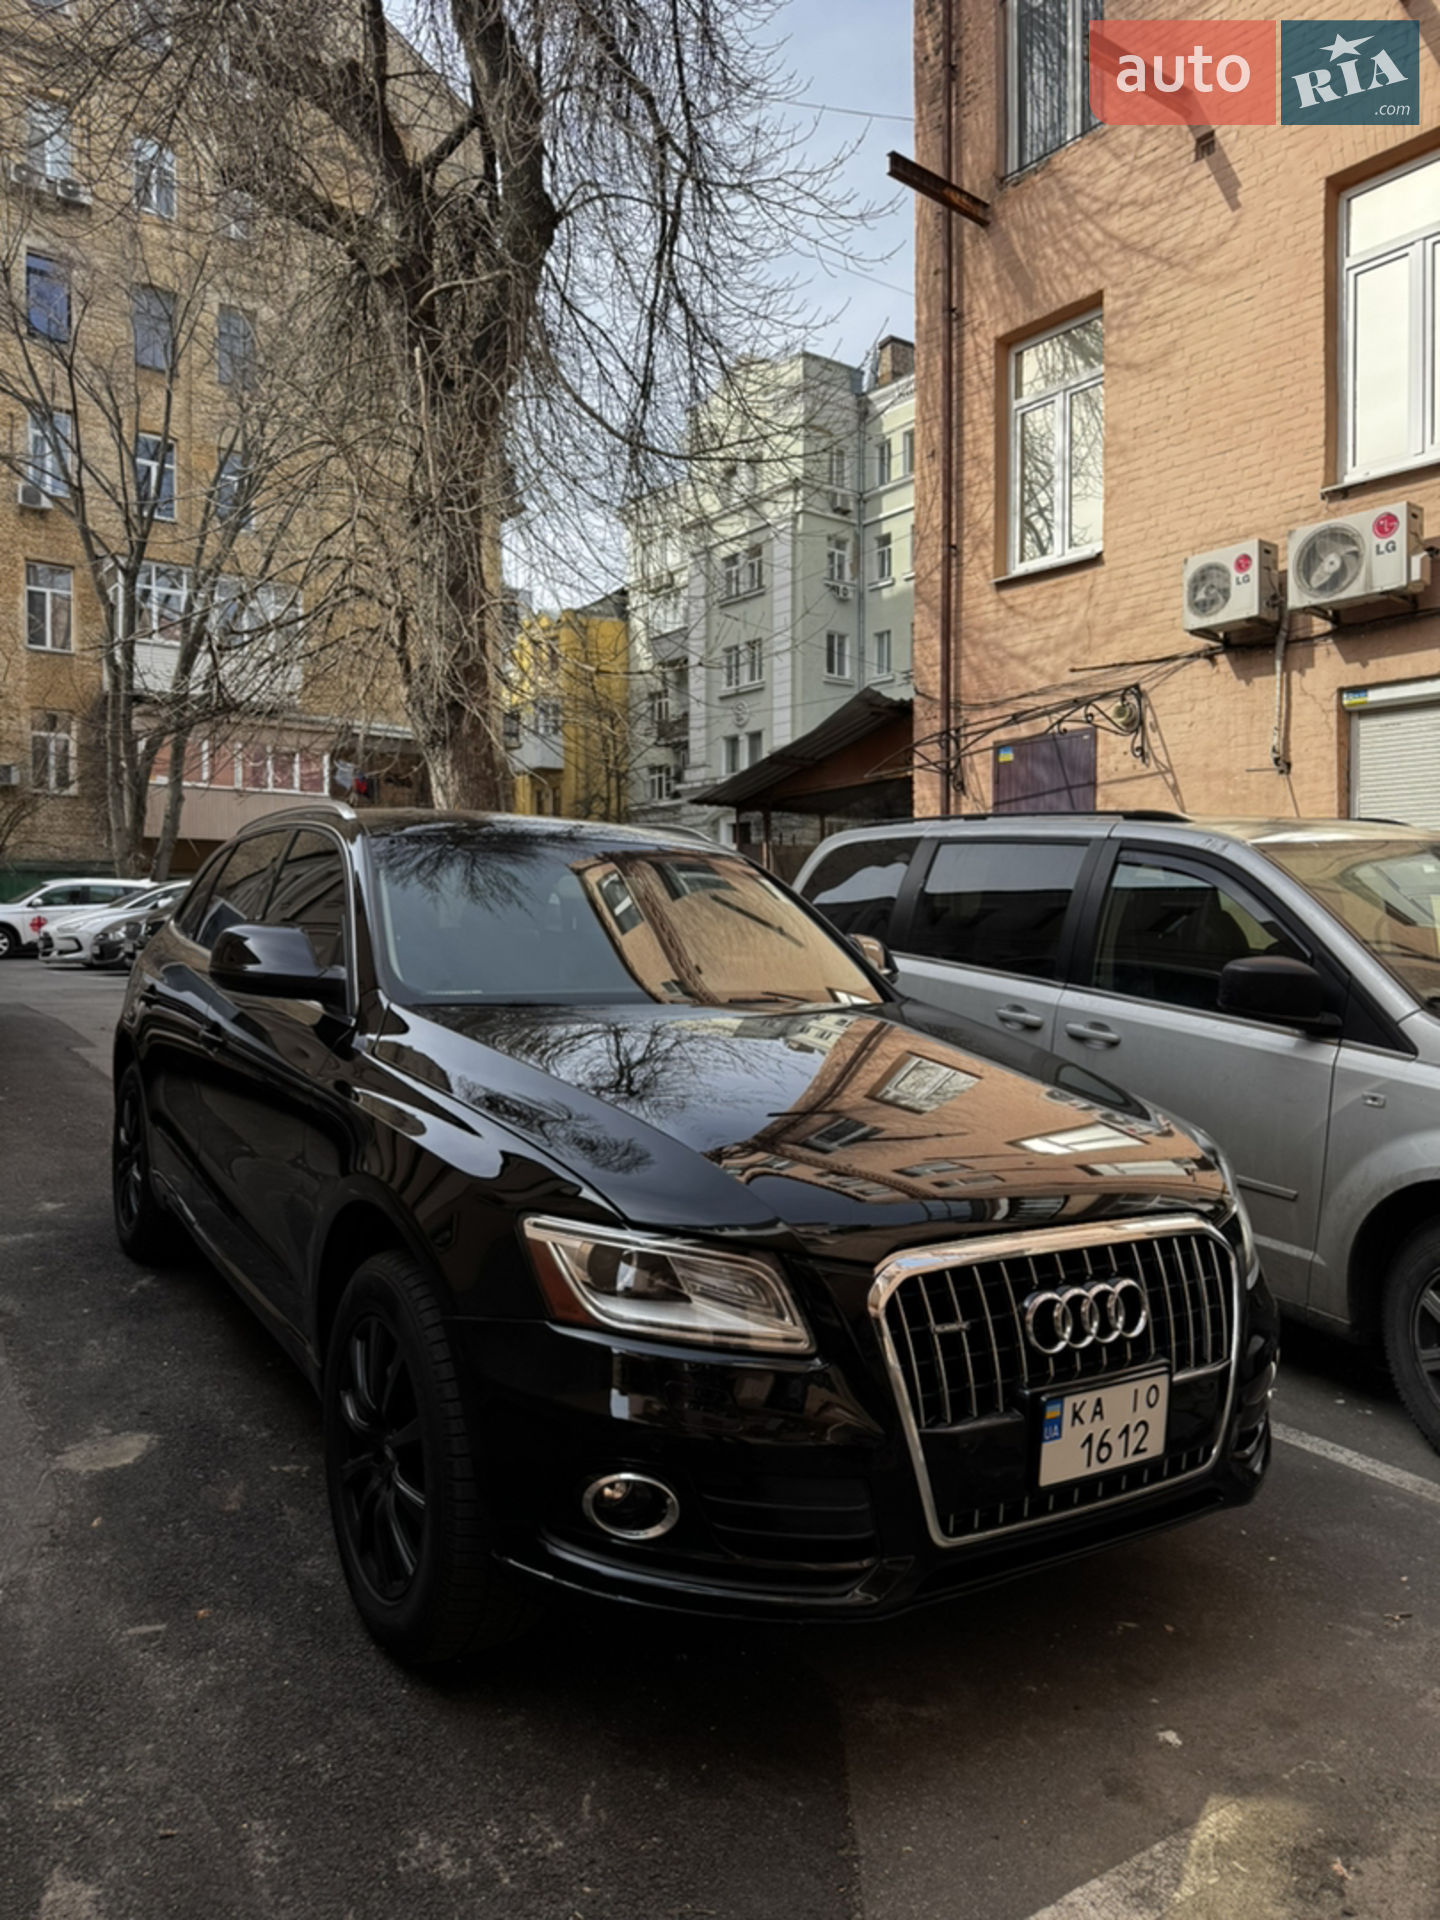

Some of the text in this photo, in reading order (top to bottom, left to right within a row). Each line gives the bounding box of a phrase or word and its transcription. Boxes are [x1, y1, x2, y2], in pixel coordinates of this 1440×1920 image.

[1375, 540, 1397, 556] LG
[1235, 573, 1251, 586] LG
[1071, 1396, 1104, 1428] KA
[1043, 1424, 1060, 1440] UA
[1080, 1419, 1149, 1468] 1612
